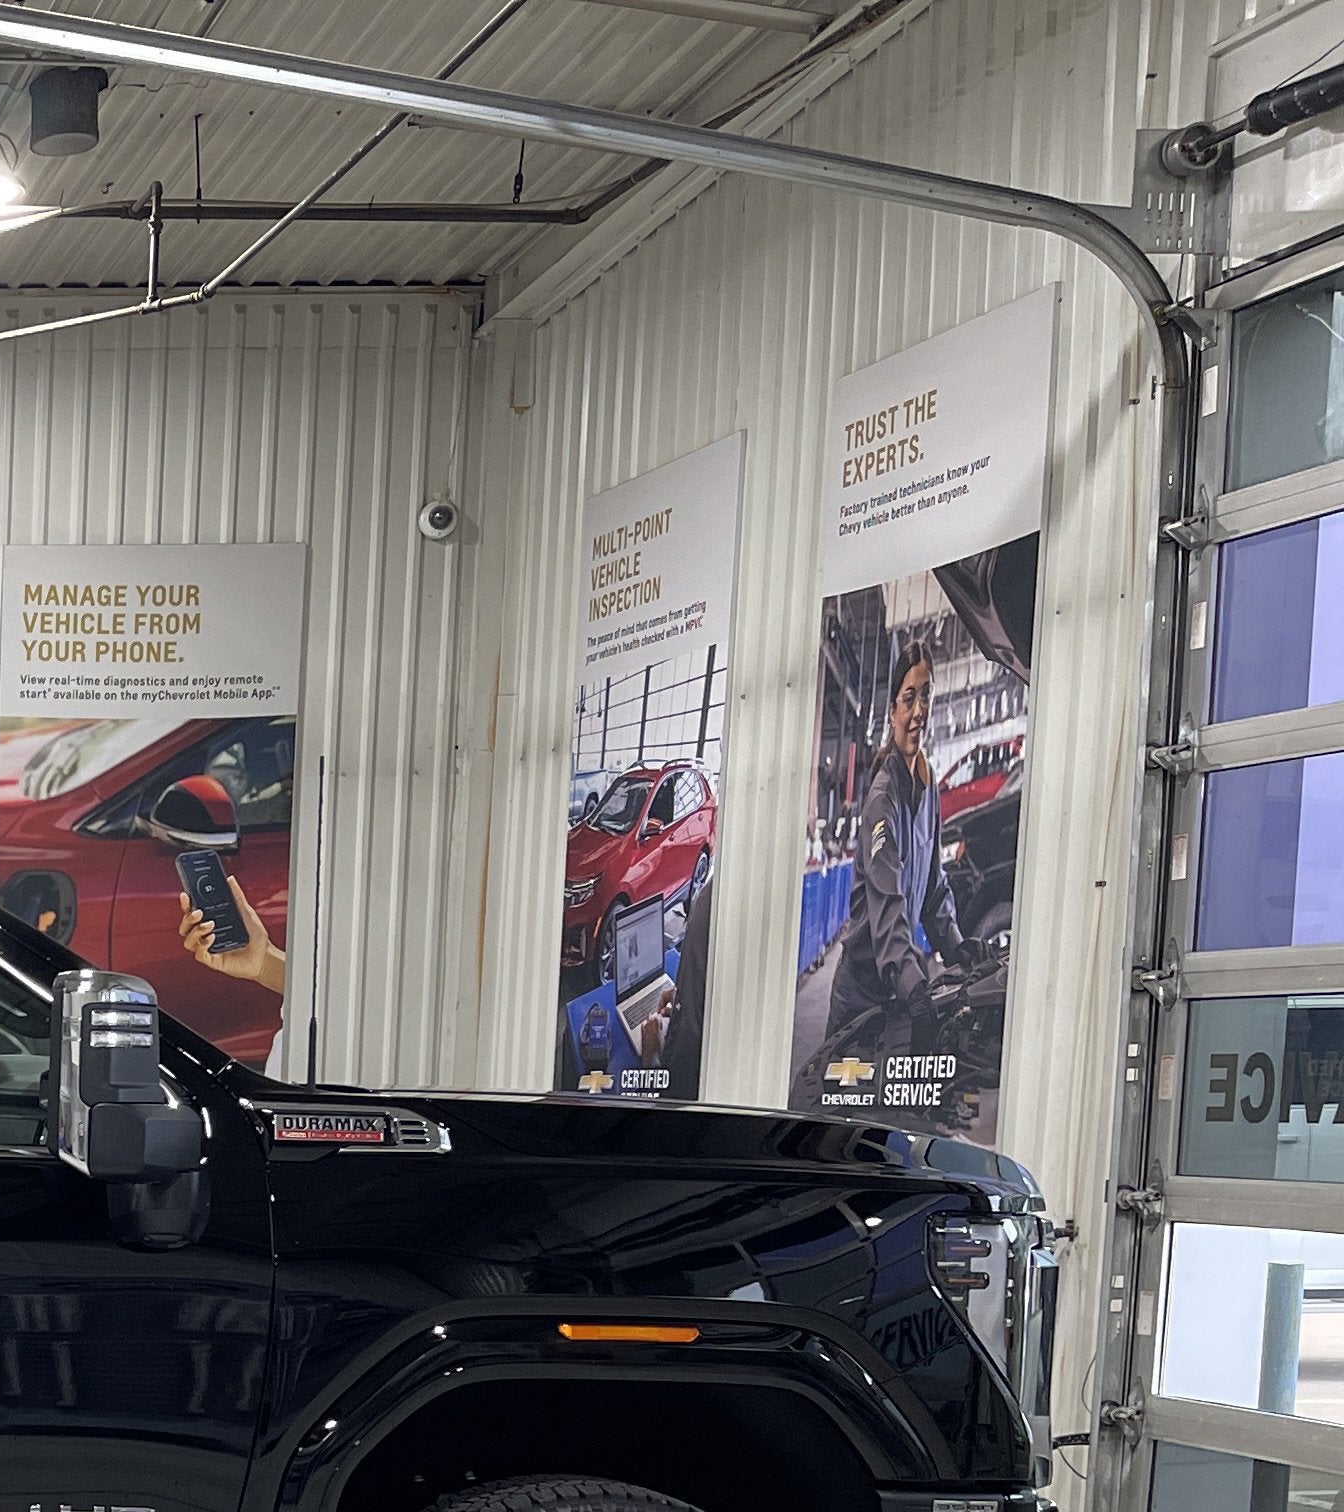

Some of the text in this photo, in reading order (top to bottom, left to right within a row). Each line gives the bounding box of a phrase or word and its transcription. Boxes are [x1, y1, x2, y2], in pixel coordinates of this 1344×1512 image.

[845, 389, 937, 451] TRUST THE
[843, 434, 924, 488] EXPERTS.
[840, 456, 990, 519] Factory trained technicians know your
[839, 483, 969, 537] Chevy vehicle better than anyone.
[592, 508, 672, 561] MULTI-POINT
[591, 551, 641, 591] VEHICLE
[24, 584, 200, 607] MANAGE YOUR
[589, 575, 662, 622] INSPECTION
[23, 612, 201, 634] VEHICLE FROM
[22, 640, 185, 663] YOUR PHONE.
[20, 674, 264, 688] View real-time diagnostics and enjoy remote
[53, 690, 101, 700] available
[104, 691, 117, 700] on
[121, 690, 138, 700] the
[142, 690, 210, 702] myChevrolet
[213, 688, 248, 699] Mobile
[886, 1055, 956, 1079] CERTIFIED
[621, 1070, 669, 1088] CERTIFIED
[822, 1094, 875, 1105] CHEVROLET
[884, 1083, 942, 1106] SERVICE
[283, 1117, 379, 1131] DURAMAX
